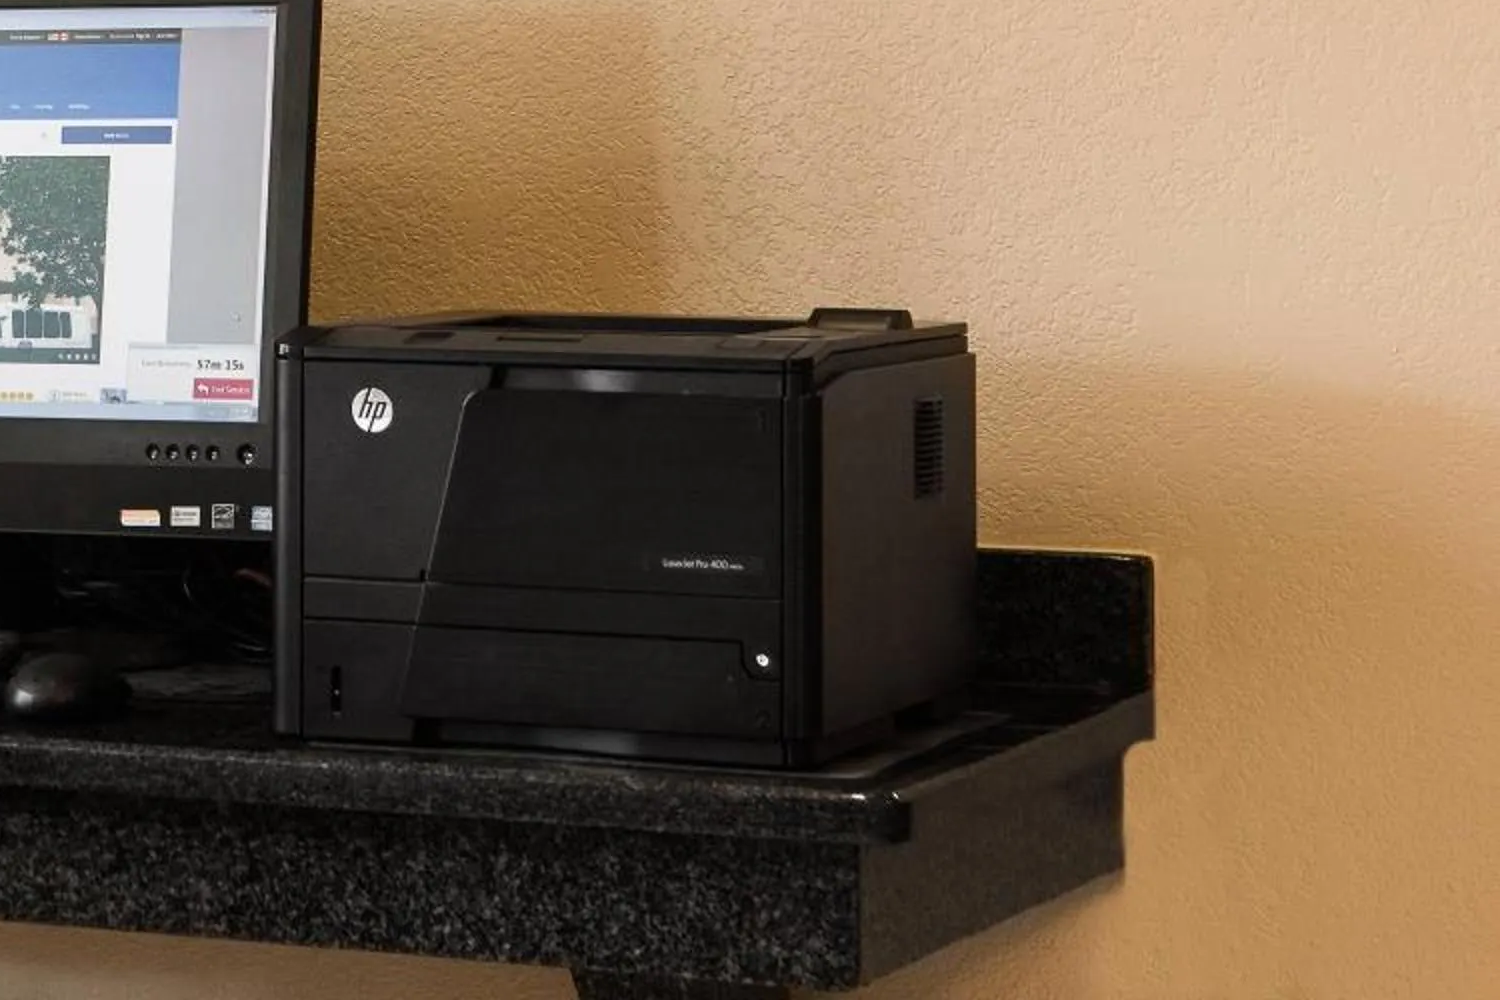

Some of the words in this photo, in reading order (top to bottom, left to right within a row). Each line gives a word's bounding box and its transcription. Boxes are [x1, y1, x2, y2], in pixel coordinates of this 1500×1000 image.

[197, 359, 222, 371] 57m
[225, 359, 245, 371] 15s
[356, 387, 389, 432] hp
[695, 559, 709, 569] Pro
[710, 559, 729, 570] 400
